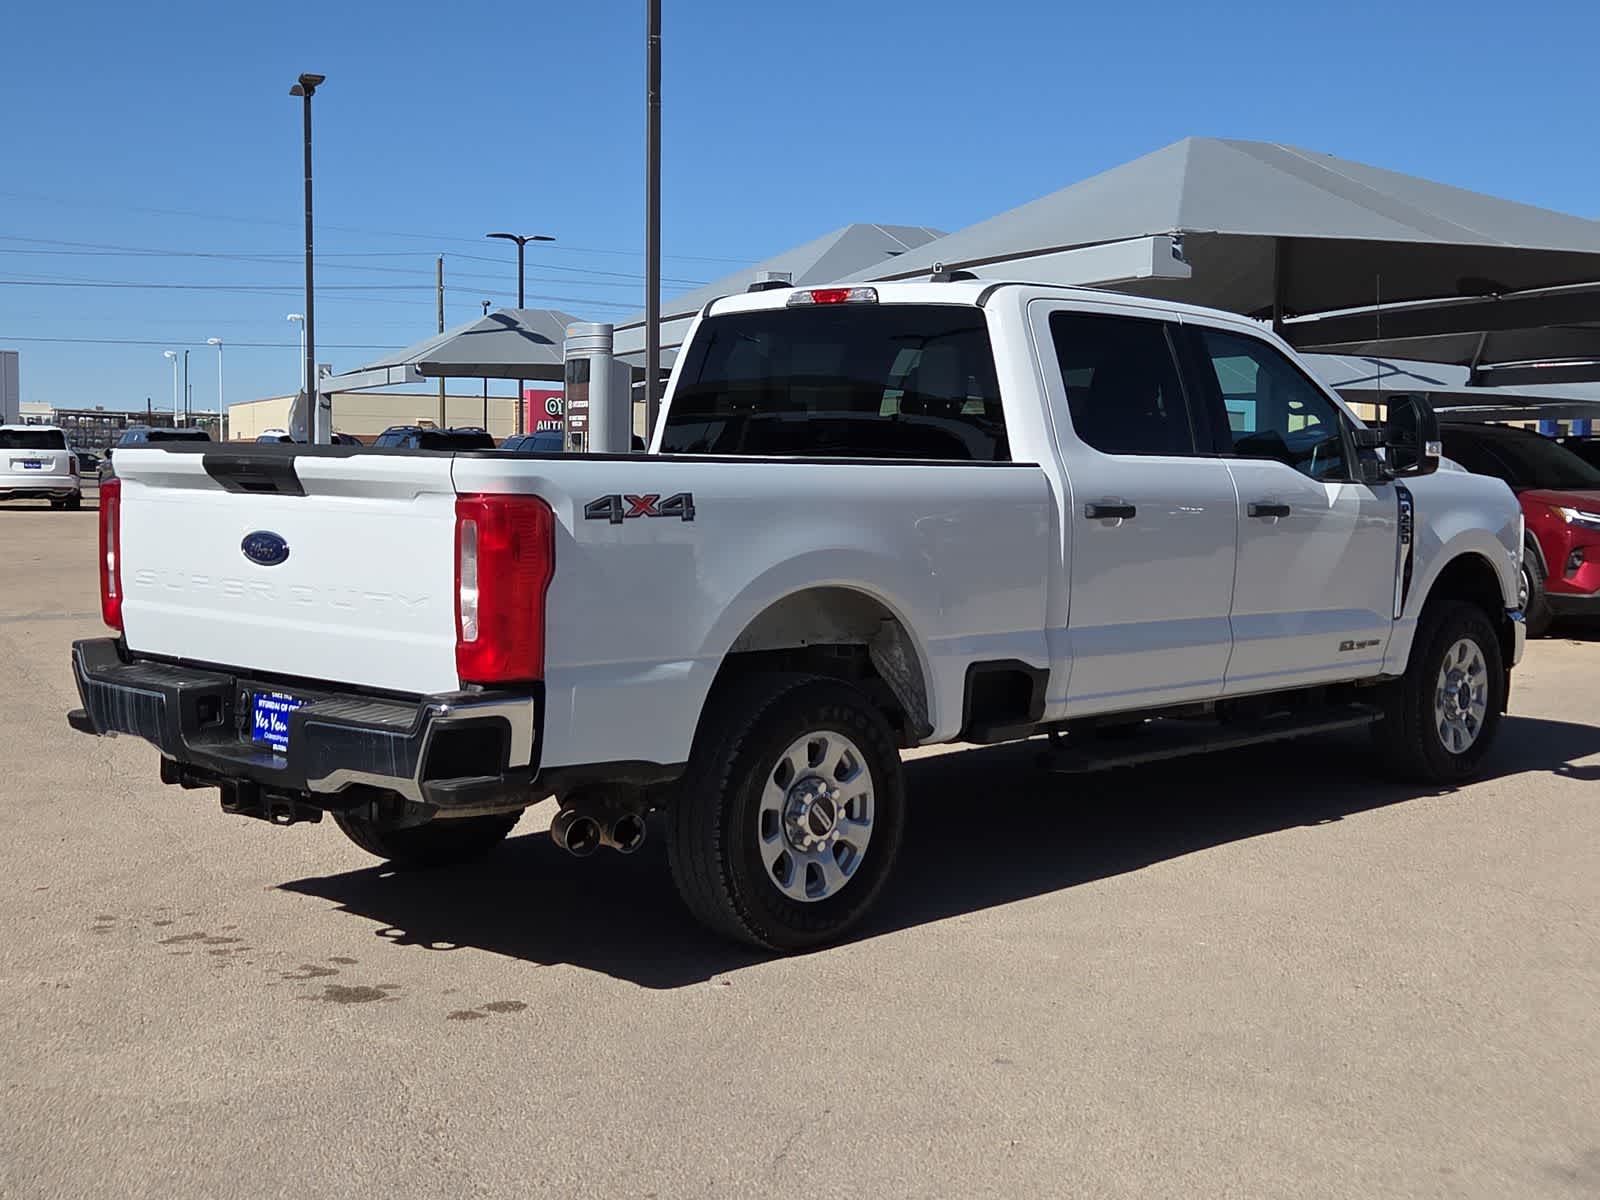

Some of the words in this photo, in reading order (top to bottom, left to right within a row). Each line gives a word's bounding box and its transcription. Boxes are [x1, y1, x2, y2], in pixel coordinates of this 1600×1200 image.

[135, 568, 280, 600] SUPER
[288, 584, 432, 616] DUTY
[255, 710, 269, 730] Yes
[271, 712, 287, 731] You
